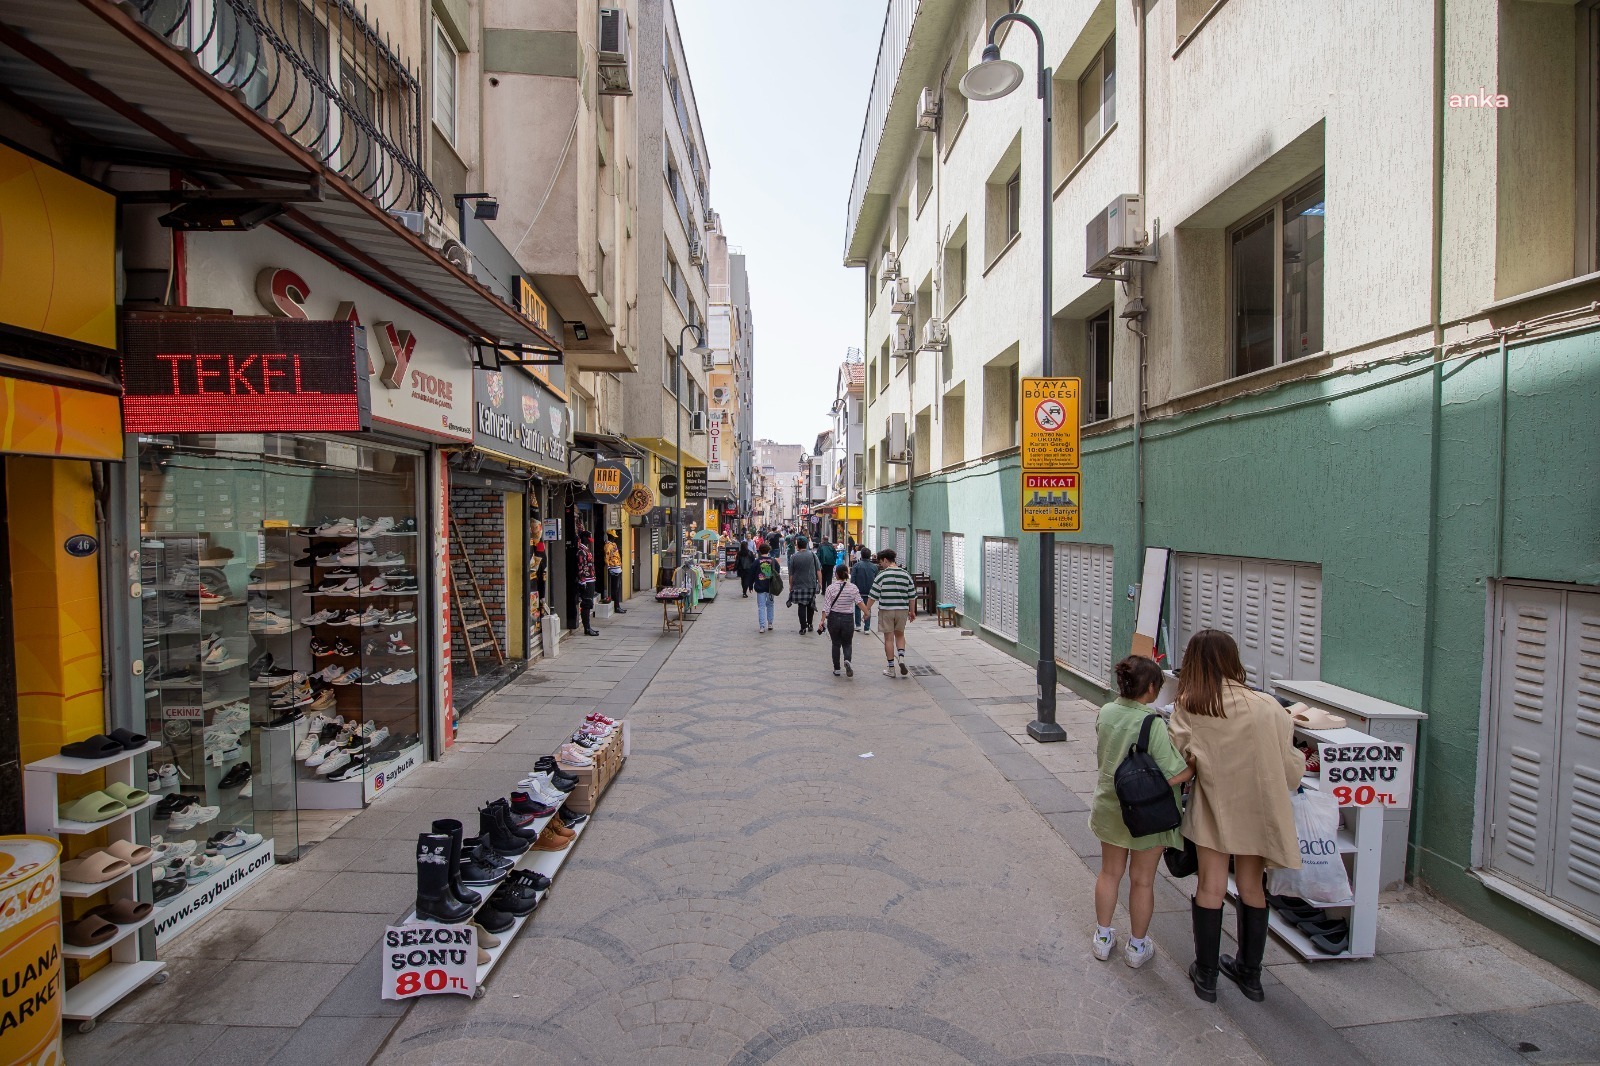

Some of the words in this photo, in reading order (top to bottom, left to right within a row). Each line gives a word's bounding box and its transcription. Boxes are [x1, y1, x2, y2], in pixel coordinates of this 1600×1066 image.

[156, 354, 321, 395] TEKEL
[411, 369, 453, 401] STORE
[1025, 389, 1077, 398] BÖLGESİ
[1034, 381, 1068, 389] YAYA
[710, 421, 720, 460] HOTEL
[597, 469, 618, 483] KARE
[1028, 477, 1073, 487] DİKKAT
[1054, 507, 1077, 516] Bariyer
[76, 540, 90, 550] 46
[165, 706, 201, 718] ÇEKİNİZ
[1323, 746, 1404, 763] SEZON
[386, 757, 415, 782] saybutik
[1328, 766, 1398, 783] SONU
[1332, 785, 1376, 806] 80
[1377, 793, 1397, 804] TL
[1297, 837, 1336, 856] acto
[154, 851, 271, 937] www.saybutik.com
[386, 928, 473, 948] SEZON
[391, 949, 468, 972] SONU
[395, 969, 448, 996] 80
[449, 977, 469, 990] TL
